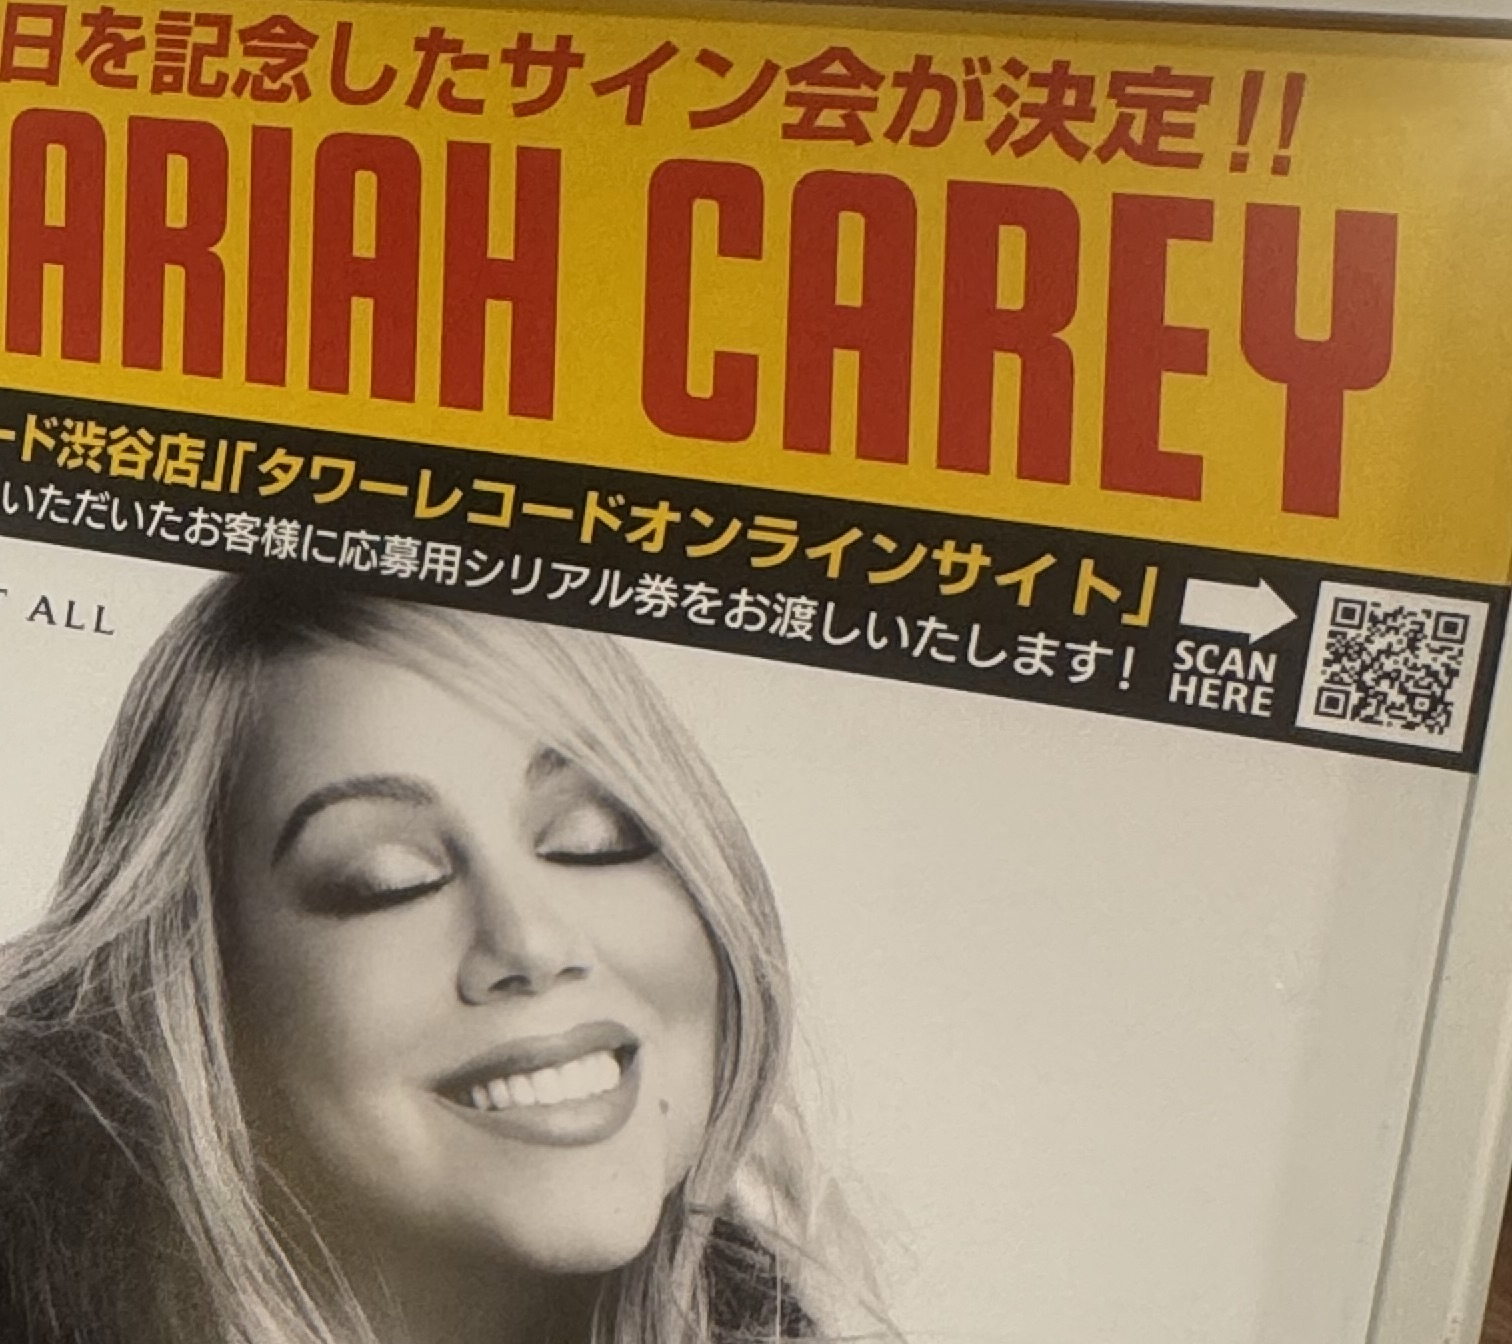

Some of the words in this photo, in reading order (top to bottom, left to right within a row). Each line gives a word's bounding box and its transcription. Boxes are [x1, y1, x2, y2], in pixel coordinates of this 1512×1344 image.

[640, 155, 1398, 523] CAREY
[25, 594, 116, 636] ALL
[1172, 640, 1277, 684] SCAN
[1168, 673, 1275, 718] HERE
